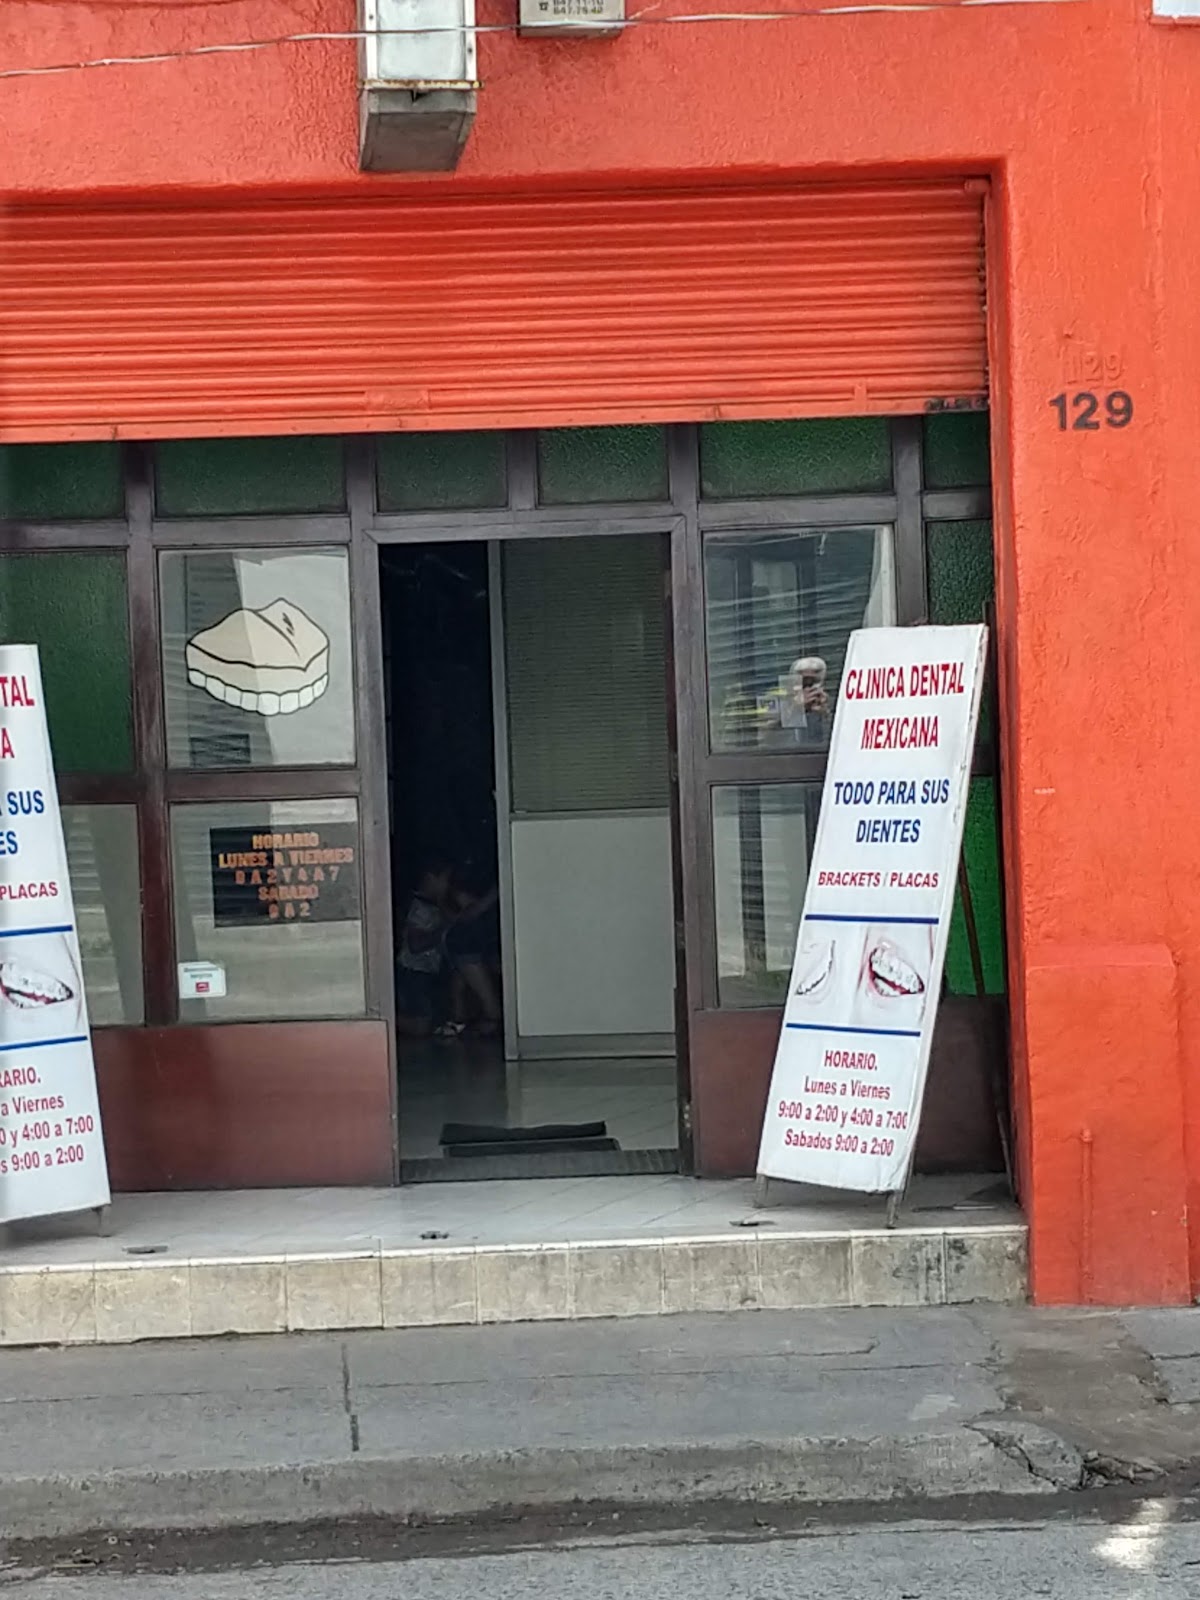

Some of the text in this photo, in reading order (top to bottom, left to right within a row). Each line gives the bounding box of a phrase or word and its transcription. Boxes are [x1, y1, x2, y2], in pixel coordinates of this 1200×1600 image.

[1048, 391, 1134, 431] 129
[845, 662, 964, 700] CLINICA DENTAL
[860, 715, 939, 749] MEXICANA
[7, 790, 44, 815] SUS
[834, 779, 950, 805] TODO PARA SUS
[252, 832, 320, 849] HORARIO
[856, 819, 921, 843] DIENTES
[218, 847, 354, 869] LUNES A VIERNES
[251, 869, 262, 884] A
[267, 868, 277, 884] 2
[282, 867, 293, 883] Y
[329, 865, 340, 881] 7
[818, 871, 881, 887] BRACKETS
[890, 872, 939, 888] PLACAS
[0, 881, 58, 900] PLACAS
[258, 884, 319, 901] SABADO
[300, 901, 311, 917] 2
[824, 1050, 878, 1071] HORARIO.
[804, 1075, 891, 1100] Lunes a Viernes
[1, 1095, 64, 1116] a Viernes
[778, 1101, 908, 1130] 9:00 a 2:00 y 4:00 a 7:00
[10, 1129, 18, 1148] y
[22, 1121, 50, 1141] 4:00
[54, 1123, 62, 1137] a
[65, 1114, 94, 1135] 7:00
[784, 1128, 894, 1156] Sabados 9:00 a 2:00
[11, 1151, 40, 1171] 9:00
[44, 1153, 53, 1167] a
[56, 1144, 84, 1165] 2:00
